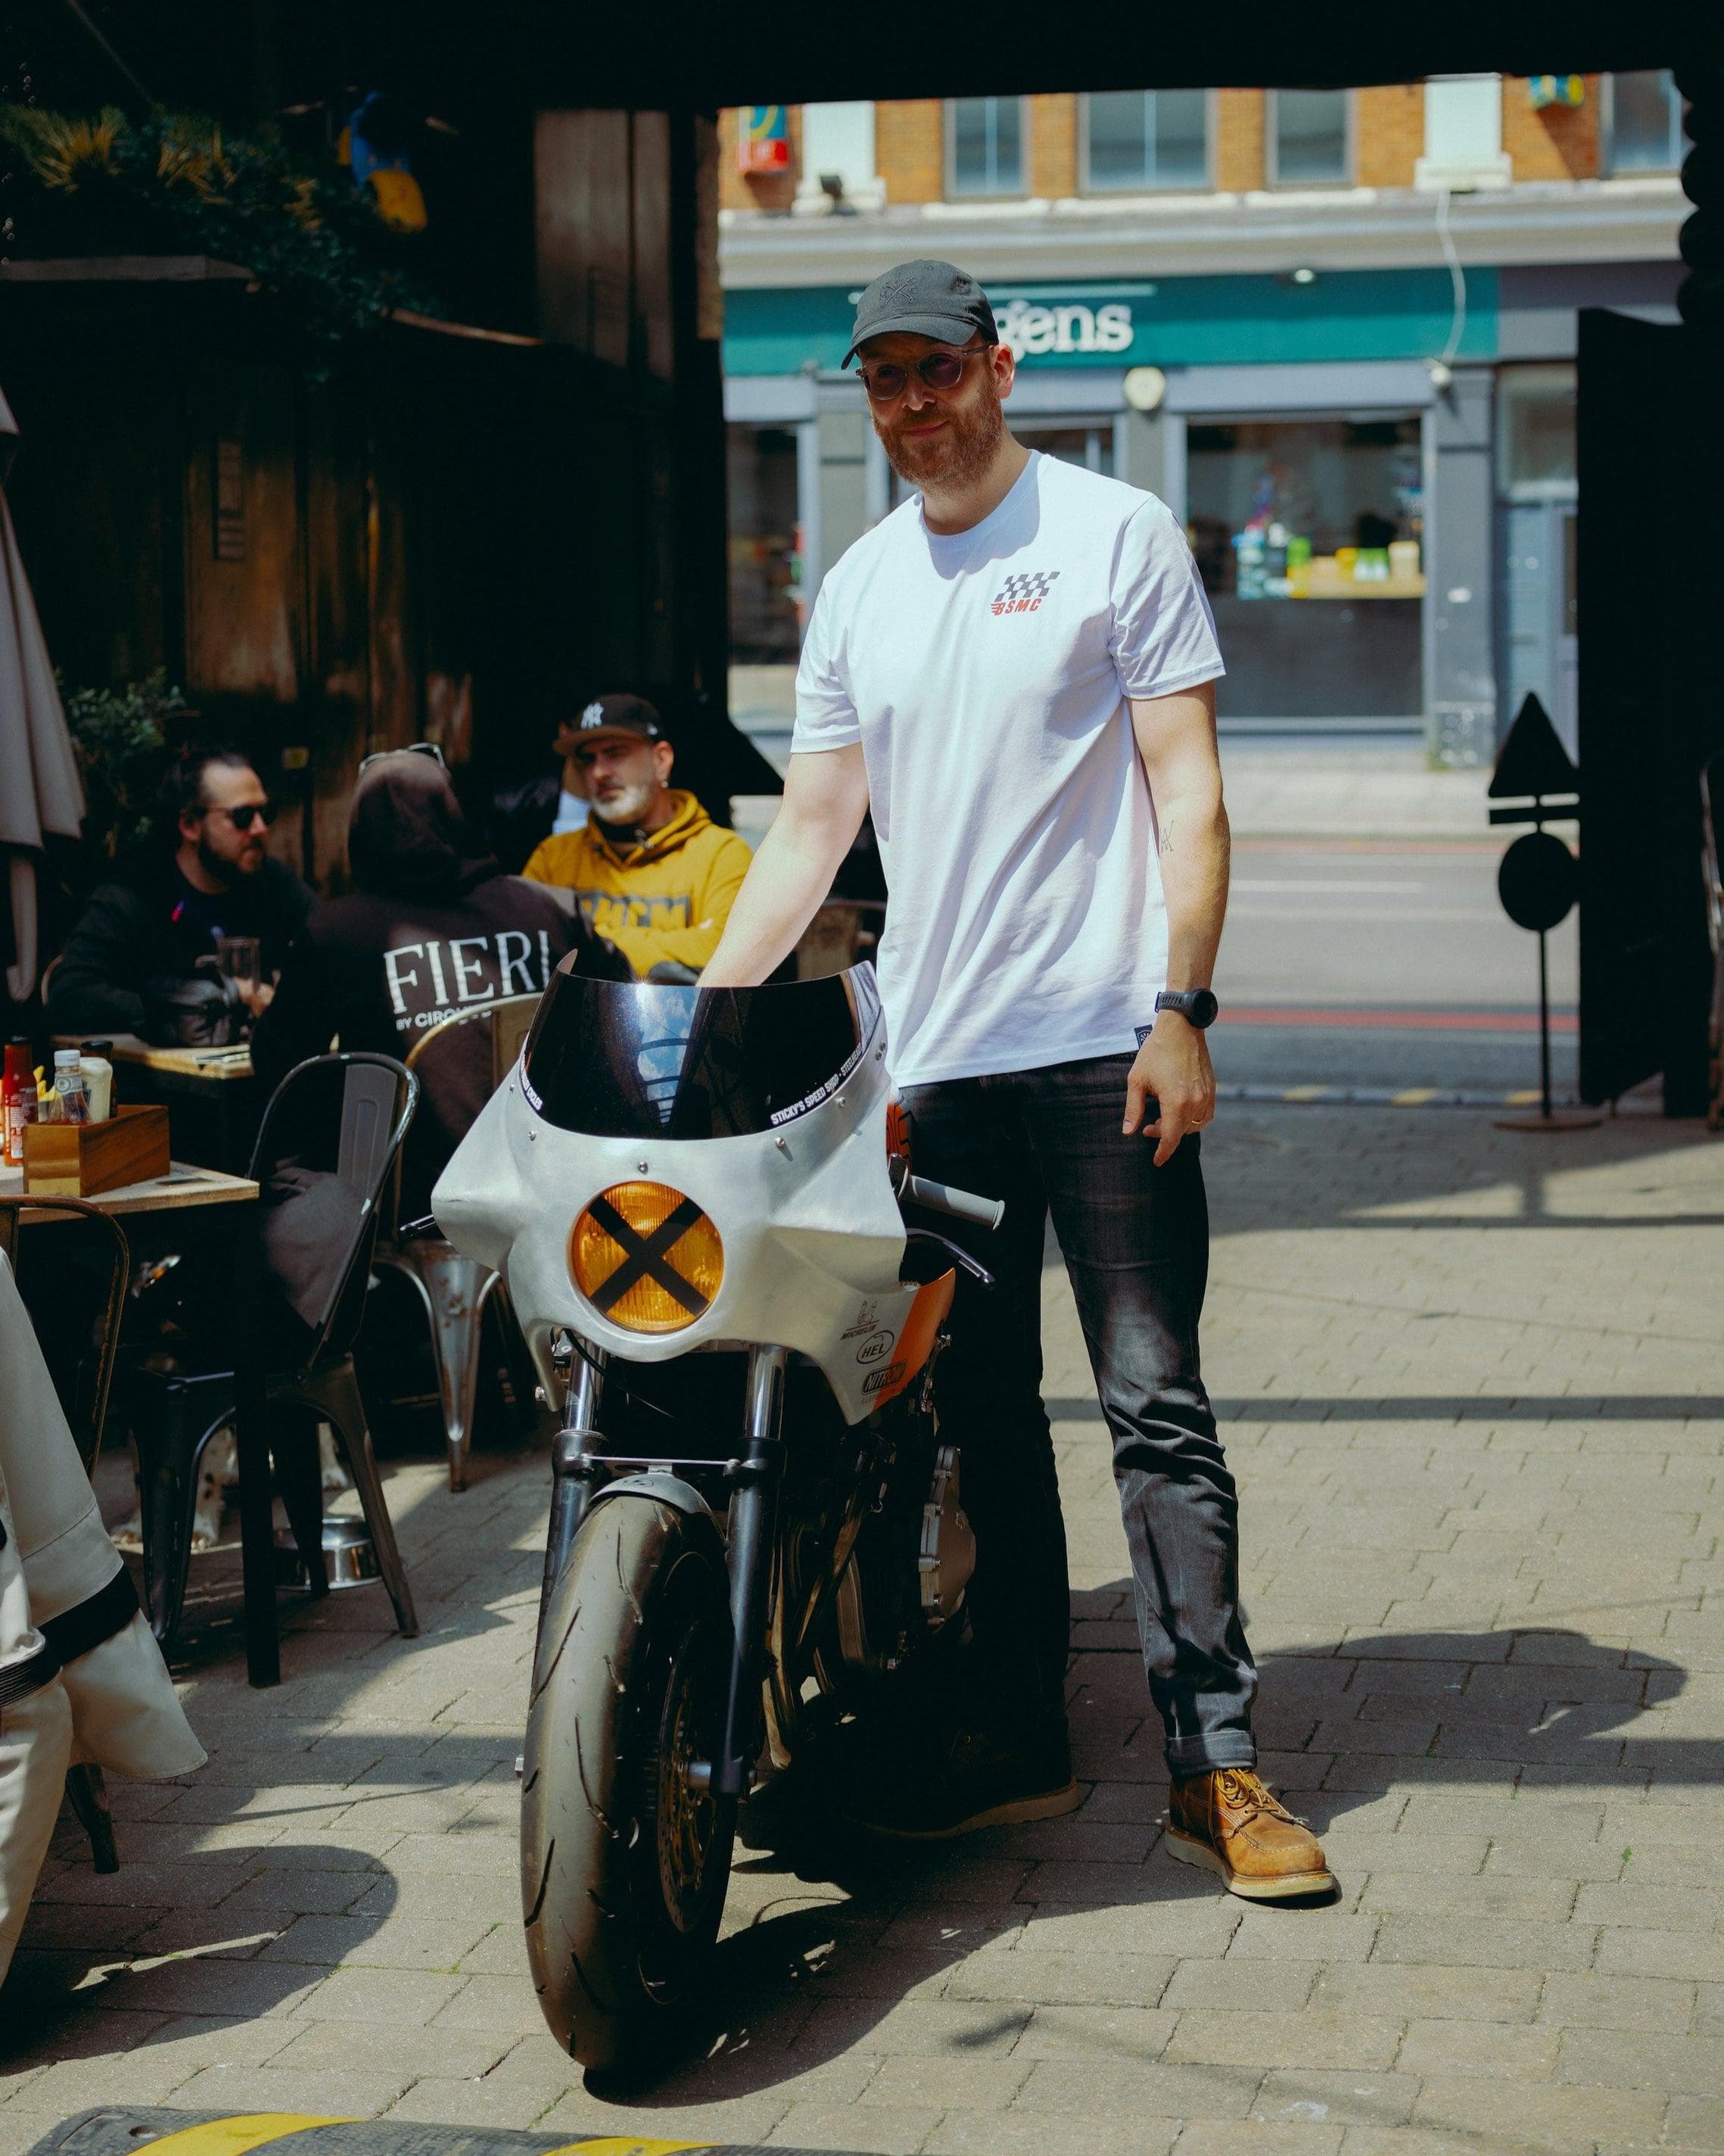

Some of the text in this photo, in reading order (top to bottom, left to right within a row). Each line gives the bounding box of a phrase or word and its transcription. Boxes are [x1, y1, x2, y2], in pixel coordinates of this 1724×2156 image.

[992, 300, 1134, 363] gens
[395, 1017, 412, 1031] BY
[770, 1100, 806, 1126] STICKY'S
[804, 1086, 827, 1108] SPEED
[823, 1073, 840, 1093] SHOP
[839, 1323, 879, 1341] MICHELIN
[861, 1343, 885, 1359] HEL
